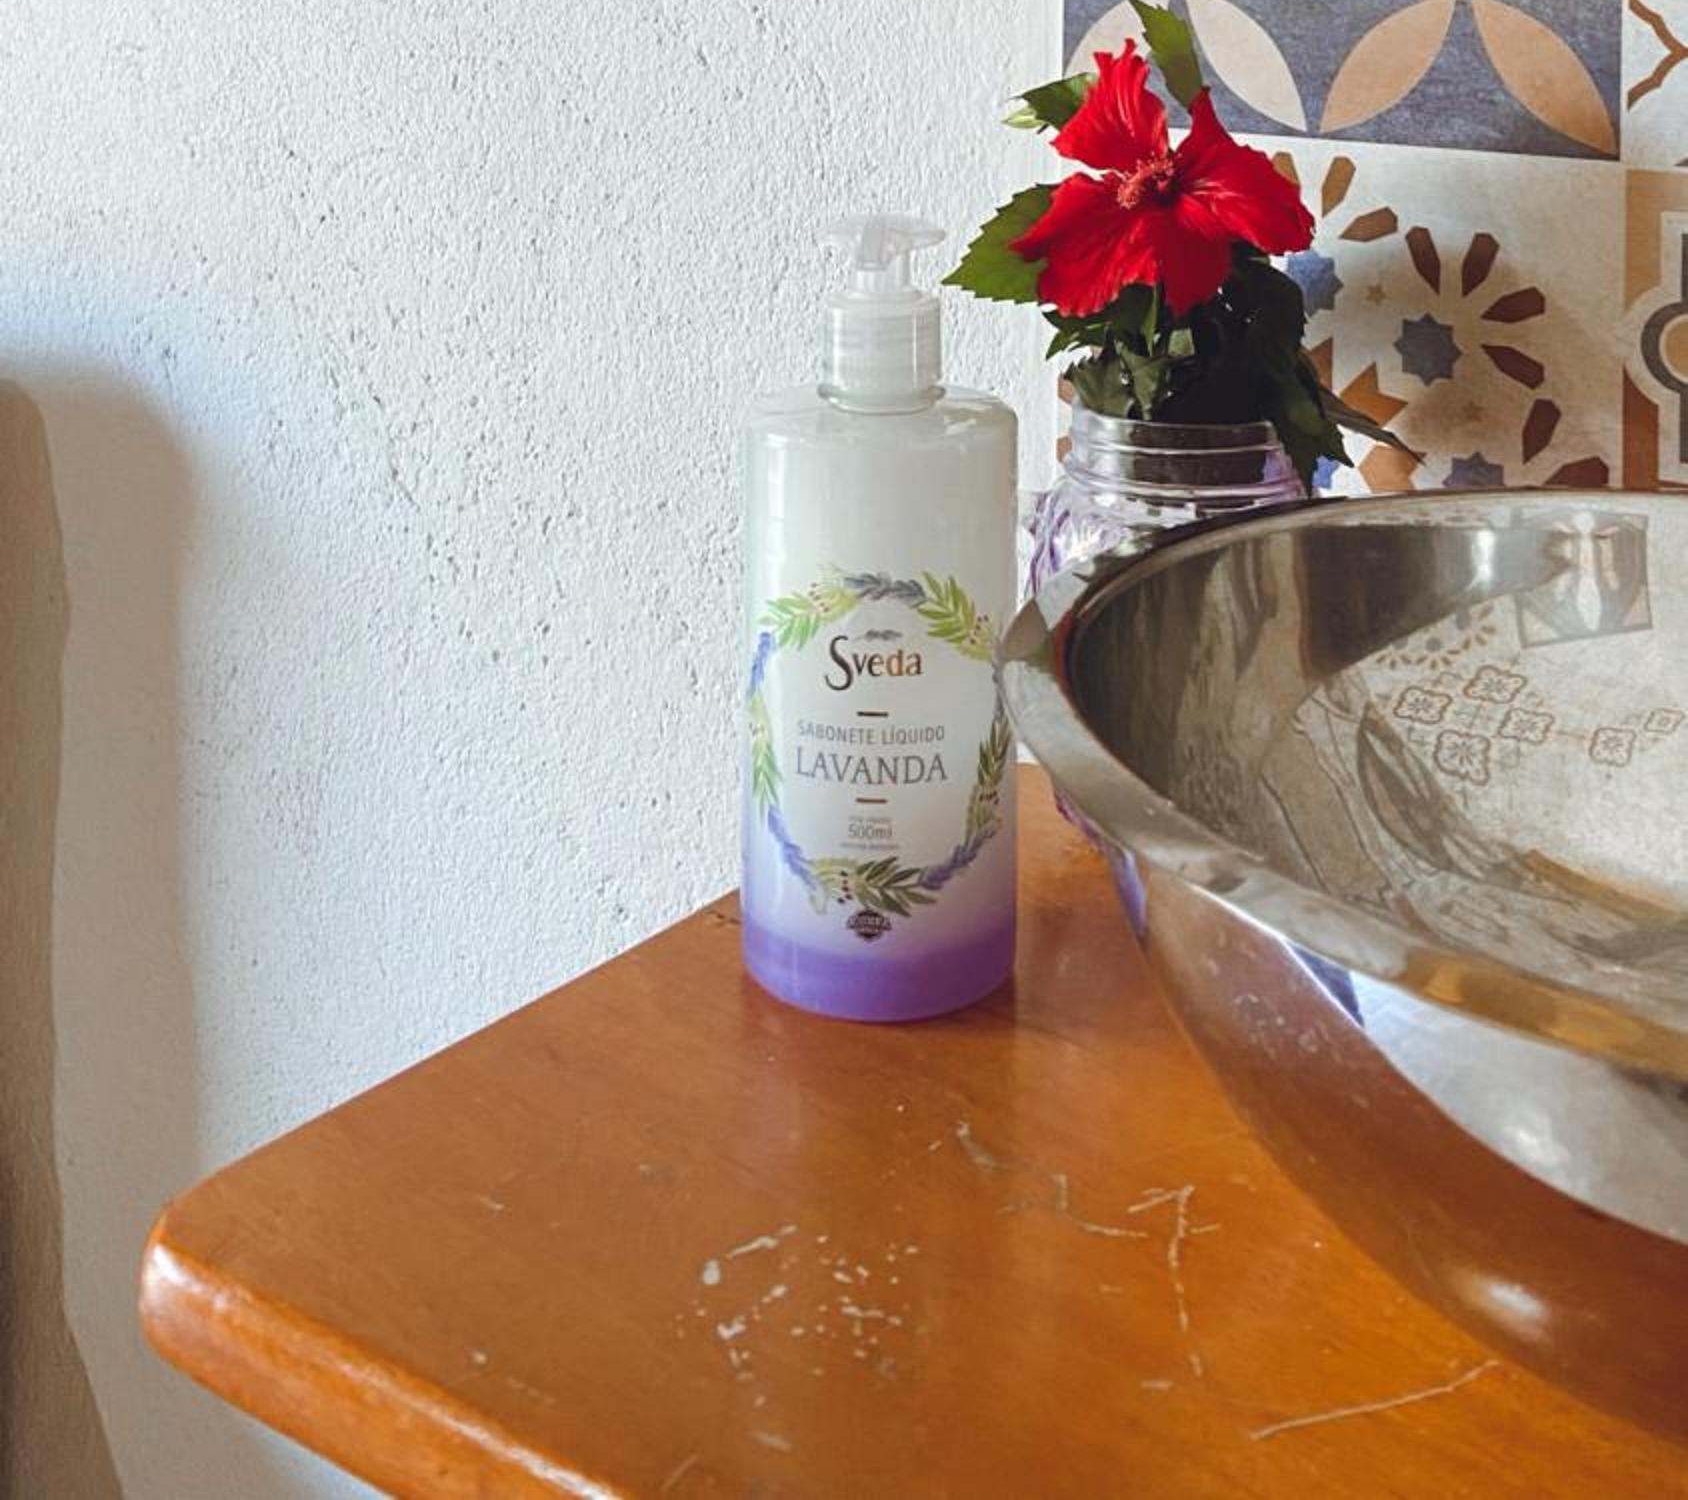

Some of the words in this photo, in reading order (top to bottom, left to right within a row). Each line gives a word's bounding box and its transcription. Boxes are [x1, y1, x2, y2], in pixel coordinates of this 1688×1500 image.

[825, 635, 923, 691] Sveda
[798, 720, 875, 745] SABONETE
[880, 724, 946, 746] LÍQUIDO
[796, 746, 948, 785] LAVANDA
[848, 824, 893, 839] 500ml
